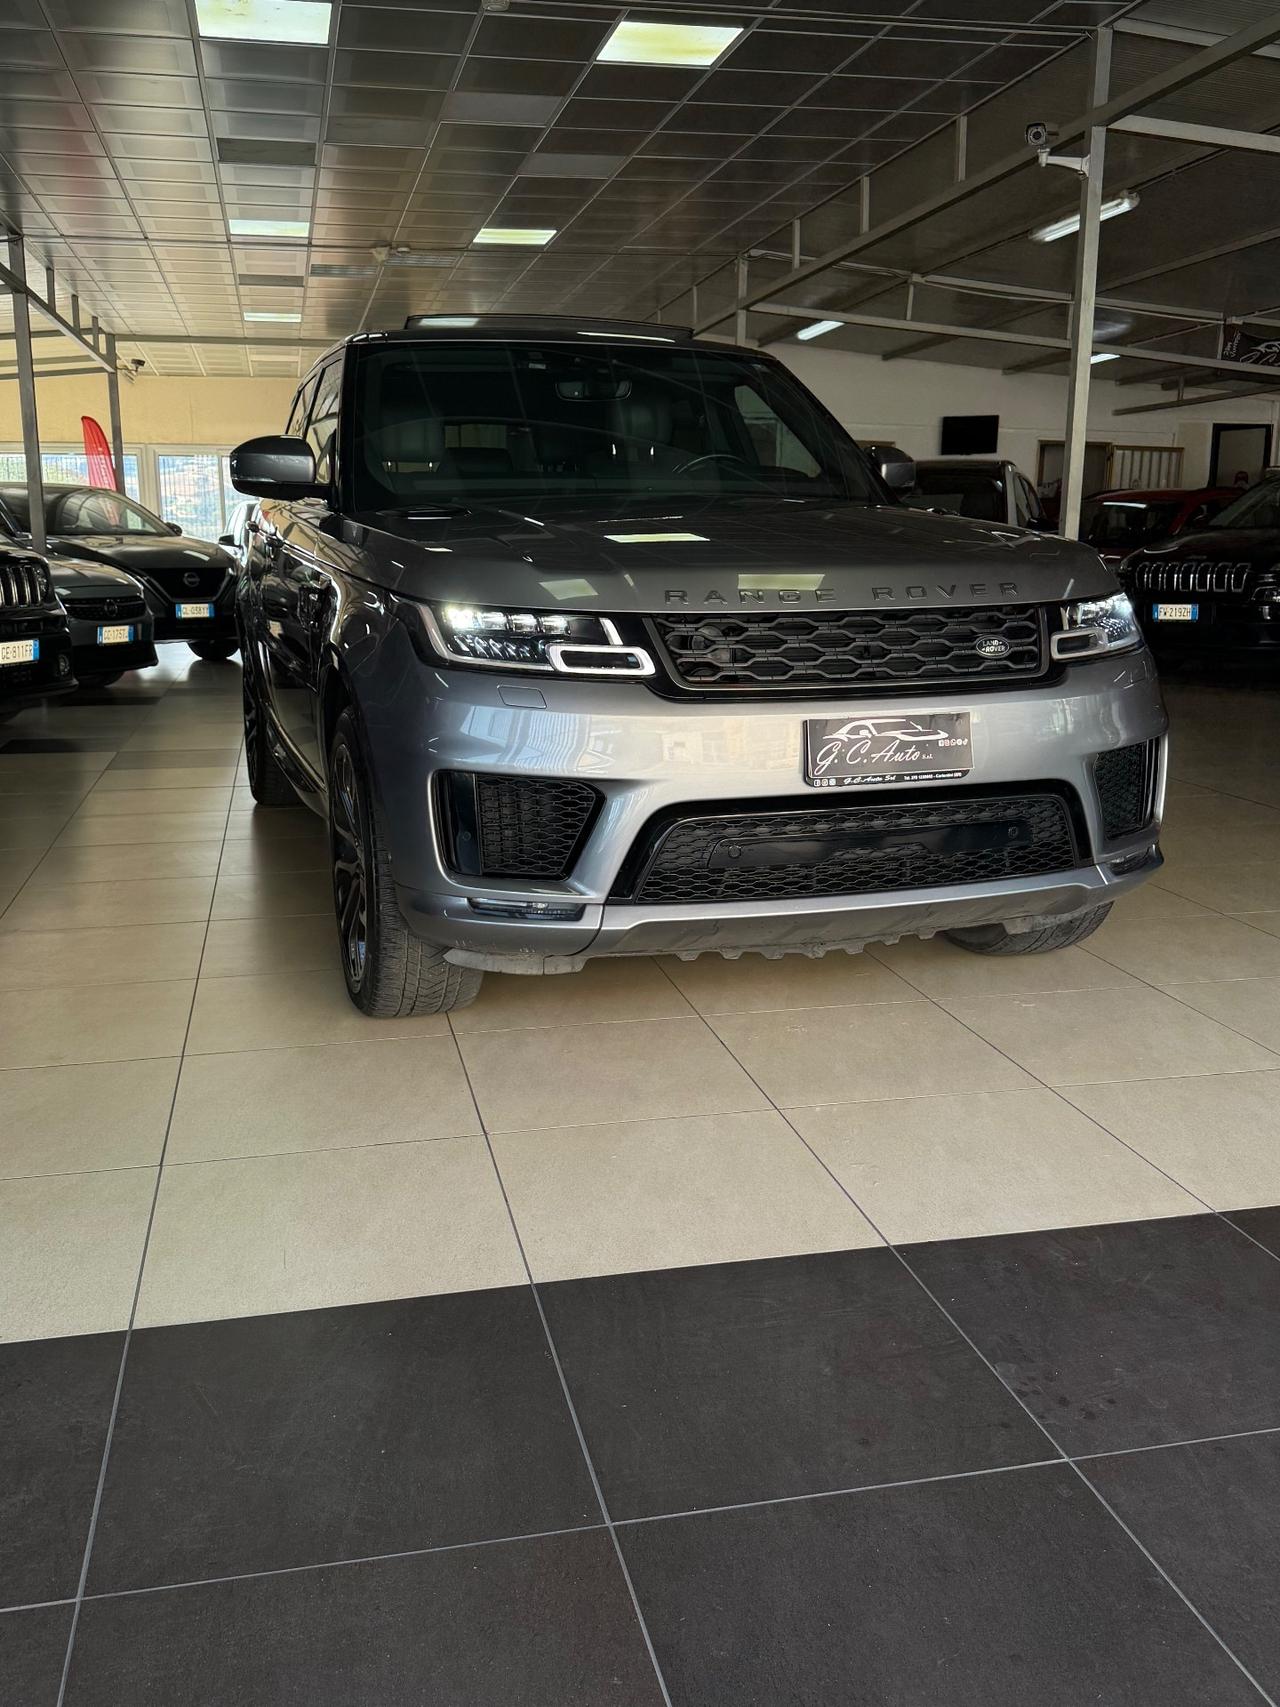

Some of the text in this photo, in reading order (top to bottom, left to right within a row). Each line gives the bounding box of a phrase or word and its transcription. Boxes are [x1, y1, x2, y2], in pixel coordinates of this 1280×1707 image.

[664, 582, 1021, 605] RANGE ROVER
[871, 740, 920, 763] Auto
